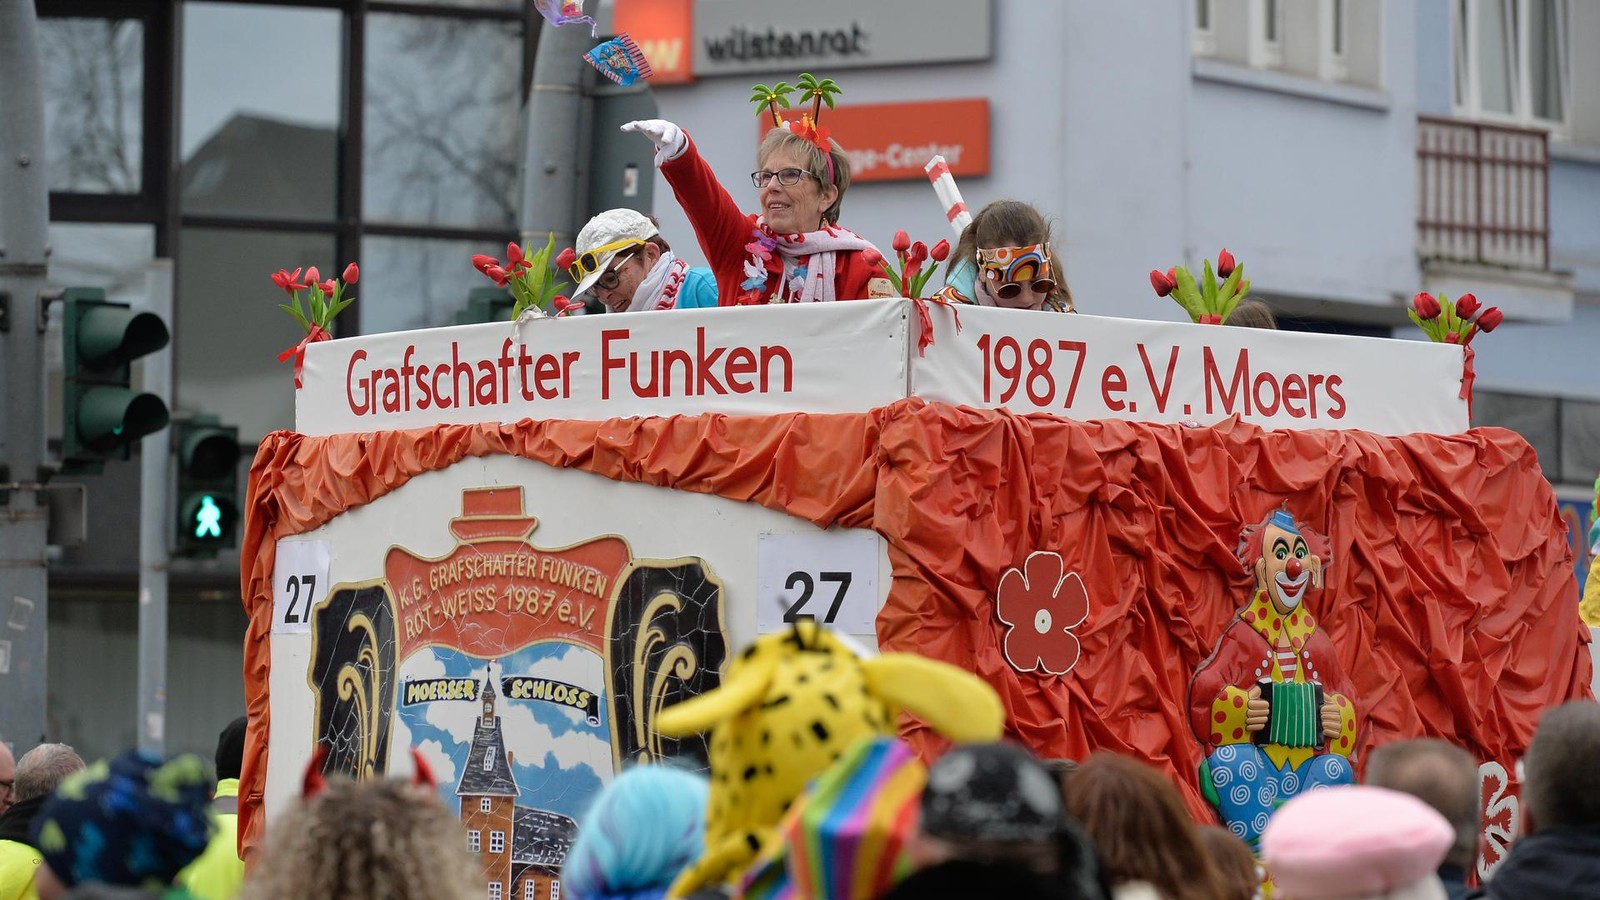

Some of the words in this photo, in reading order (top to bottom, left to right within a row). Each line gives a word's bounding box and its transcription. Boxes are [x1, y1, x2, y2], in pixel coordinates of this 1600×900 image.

[849, 142, 964, 175] ge-Center
[346, 337, 581, 416] Grafschafter
[601, 326, 793, 400] Funken
[977, 334, 1087, 407] 1987
[1101, 343, 1192, 415] e.V.
[1203, 346, 1347, 419] Moers
[285, 575, 316, 623] 27
[430, 552, 537, 592] GRAFSCHAFTER
[541, 557, 608, 599] FUNKEN
[783, 571, 852, 623] 27
[405, 585, 497, 640] ROT-WEISS
[506, 585, 557, 615] 1987
[558, 600, 595, 630] e.V.
[407, 680, 476, 703] MOERSER
[511, 679, 591, 708] SCHLOSS
